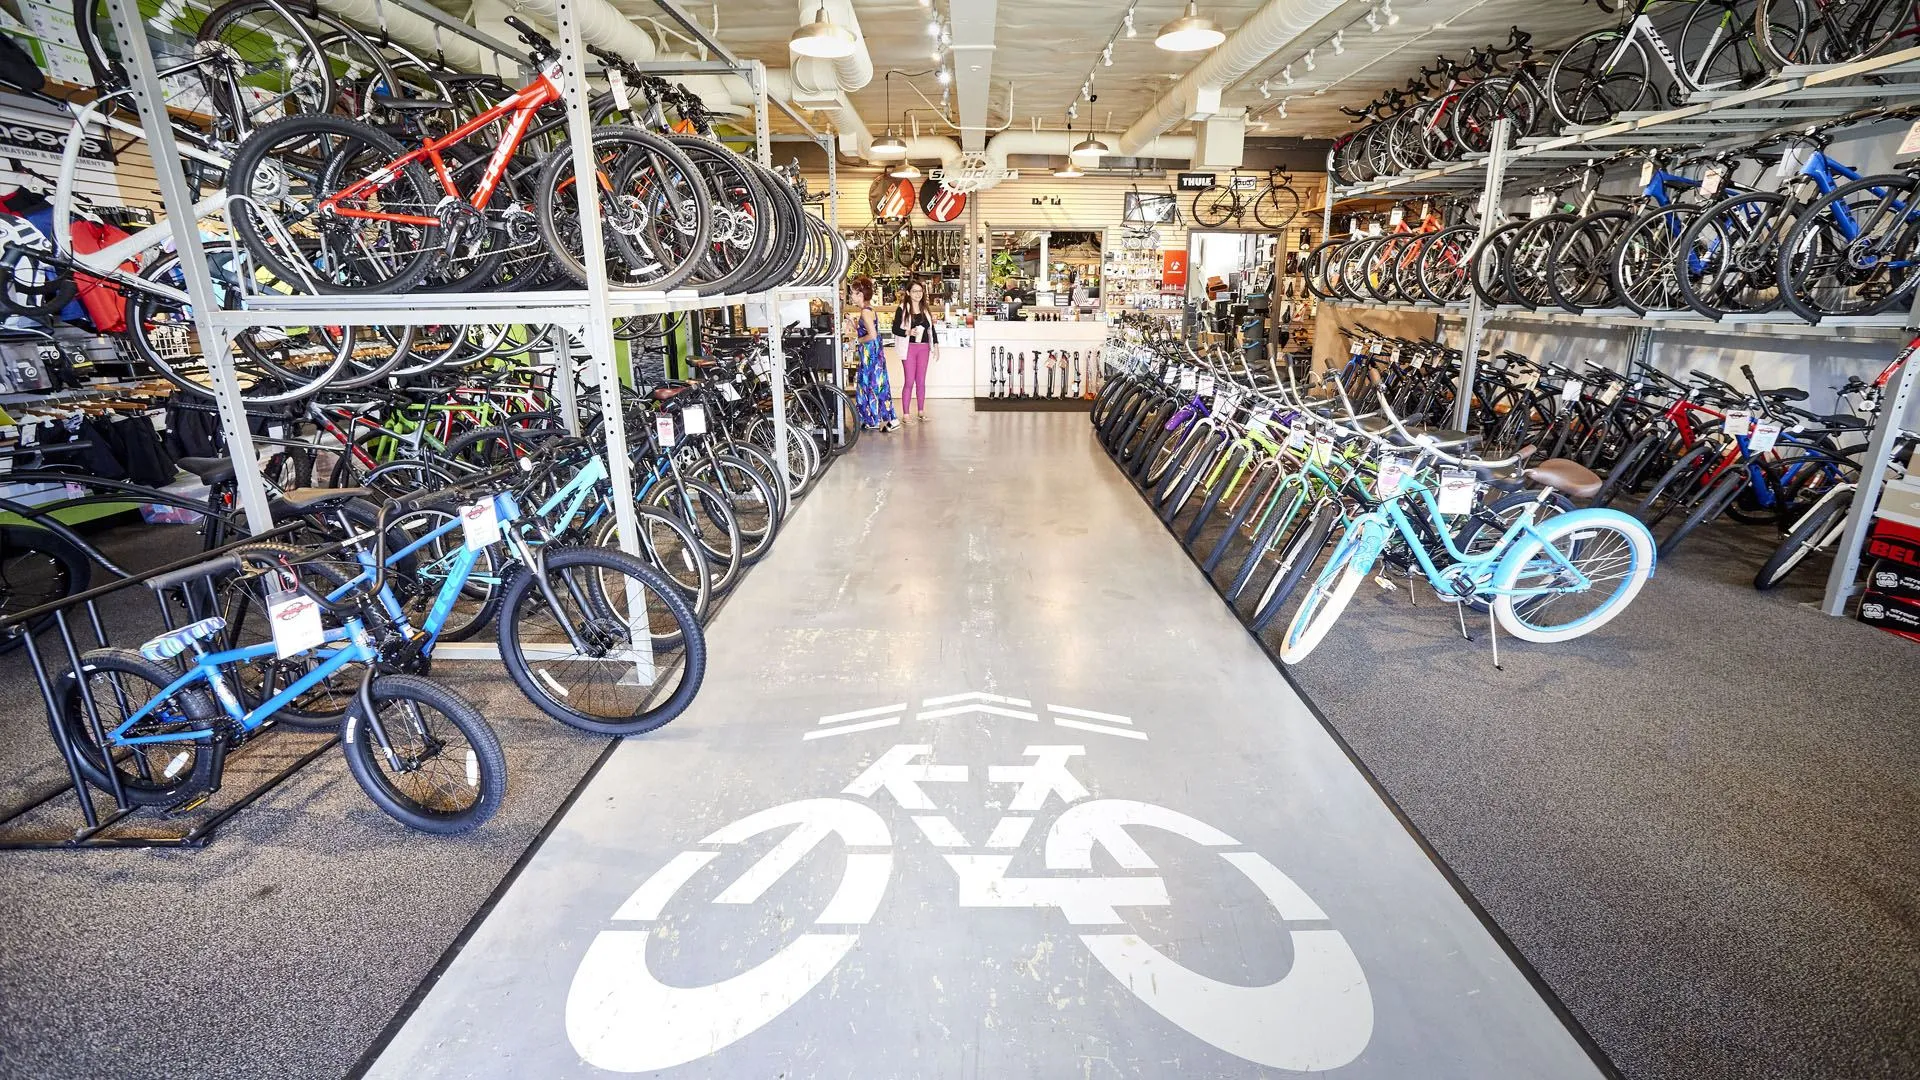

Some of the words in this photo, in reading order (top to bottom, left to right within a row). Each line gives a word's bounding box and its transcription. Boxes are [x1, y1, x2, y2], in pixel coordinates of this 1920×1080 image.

[476, 108, 527, 192] TREK
[1182, 177, 1211, 186] THULE
[1869, 540, 1920, 567] BEL
